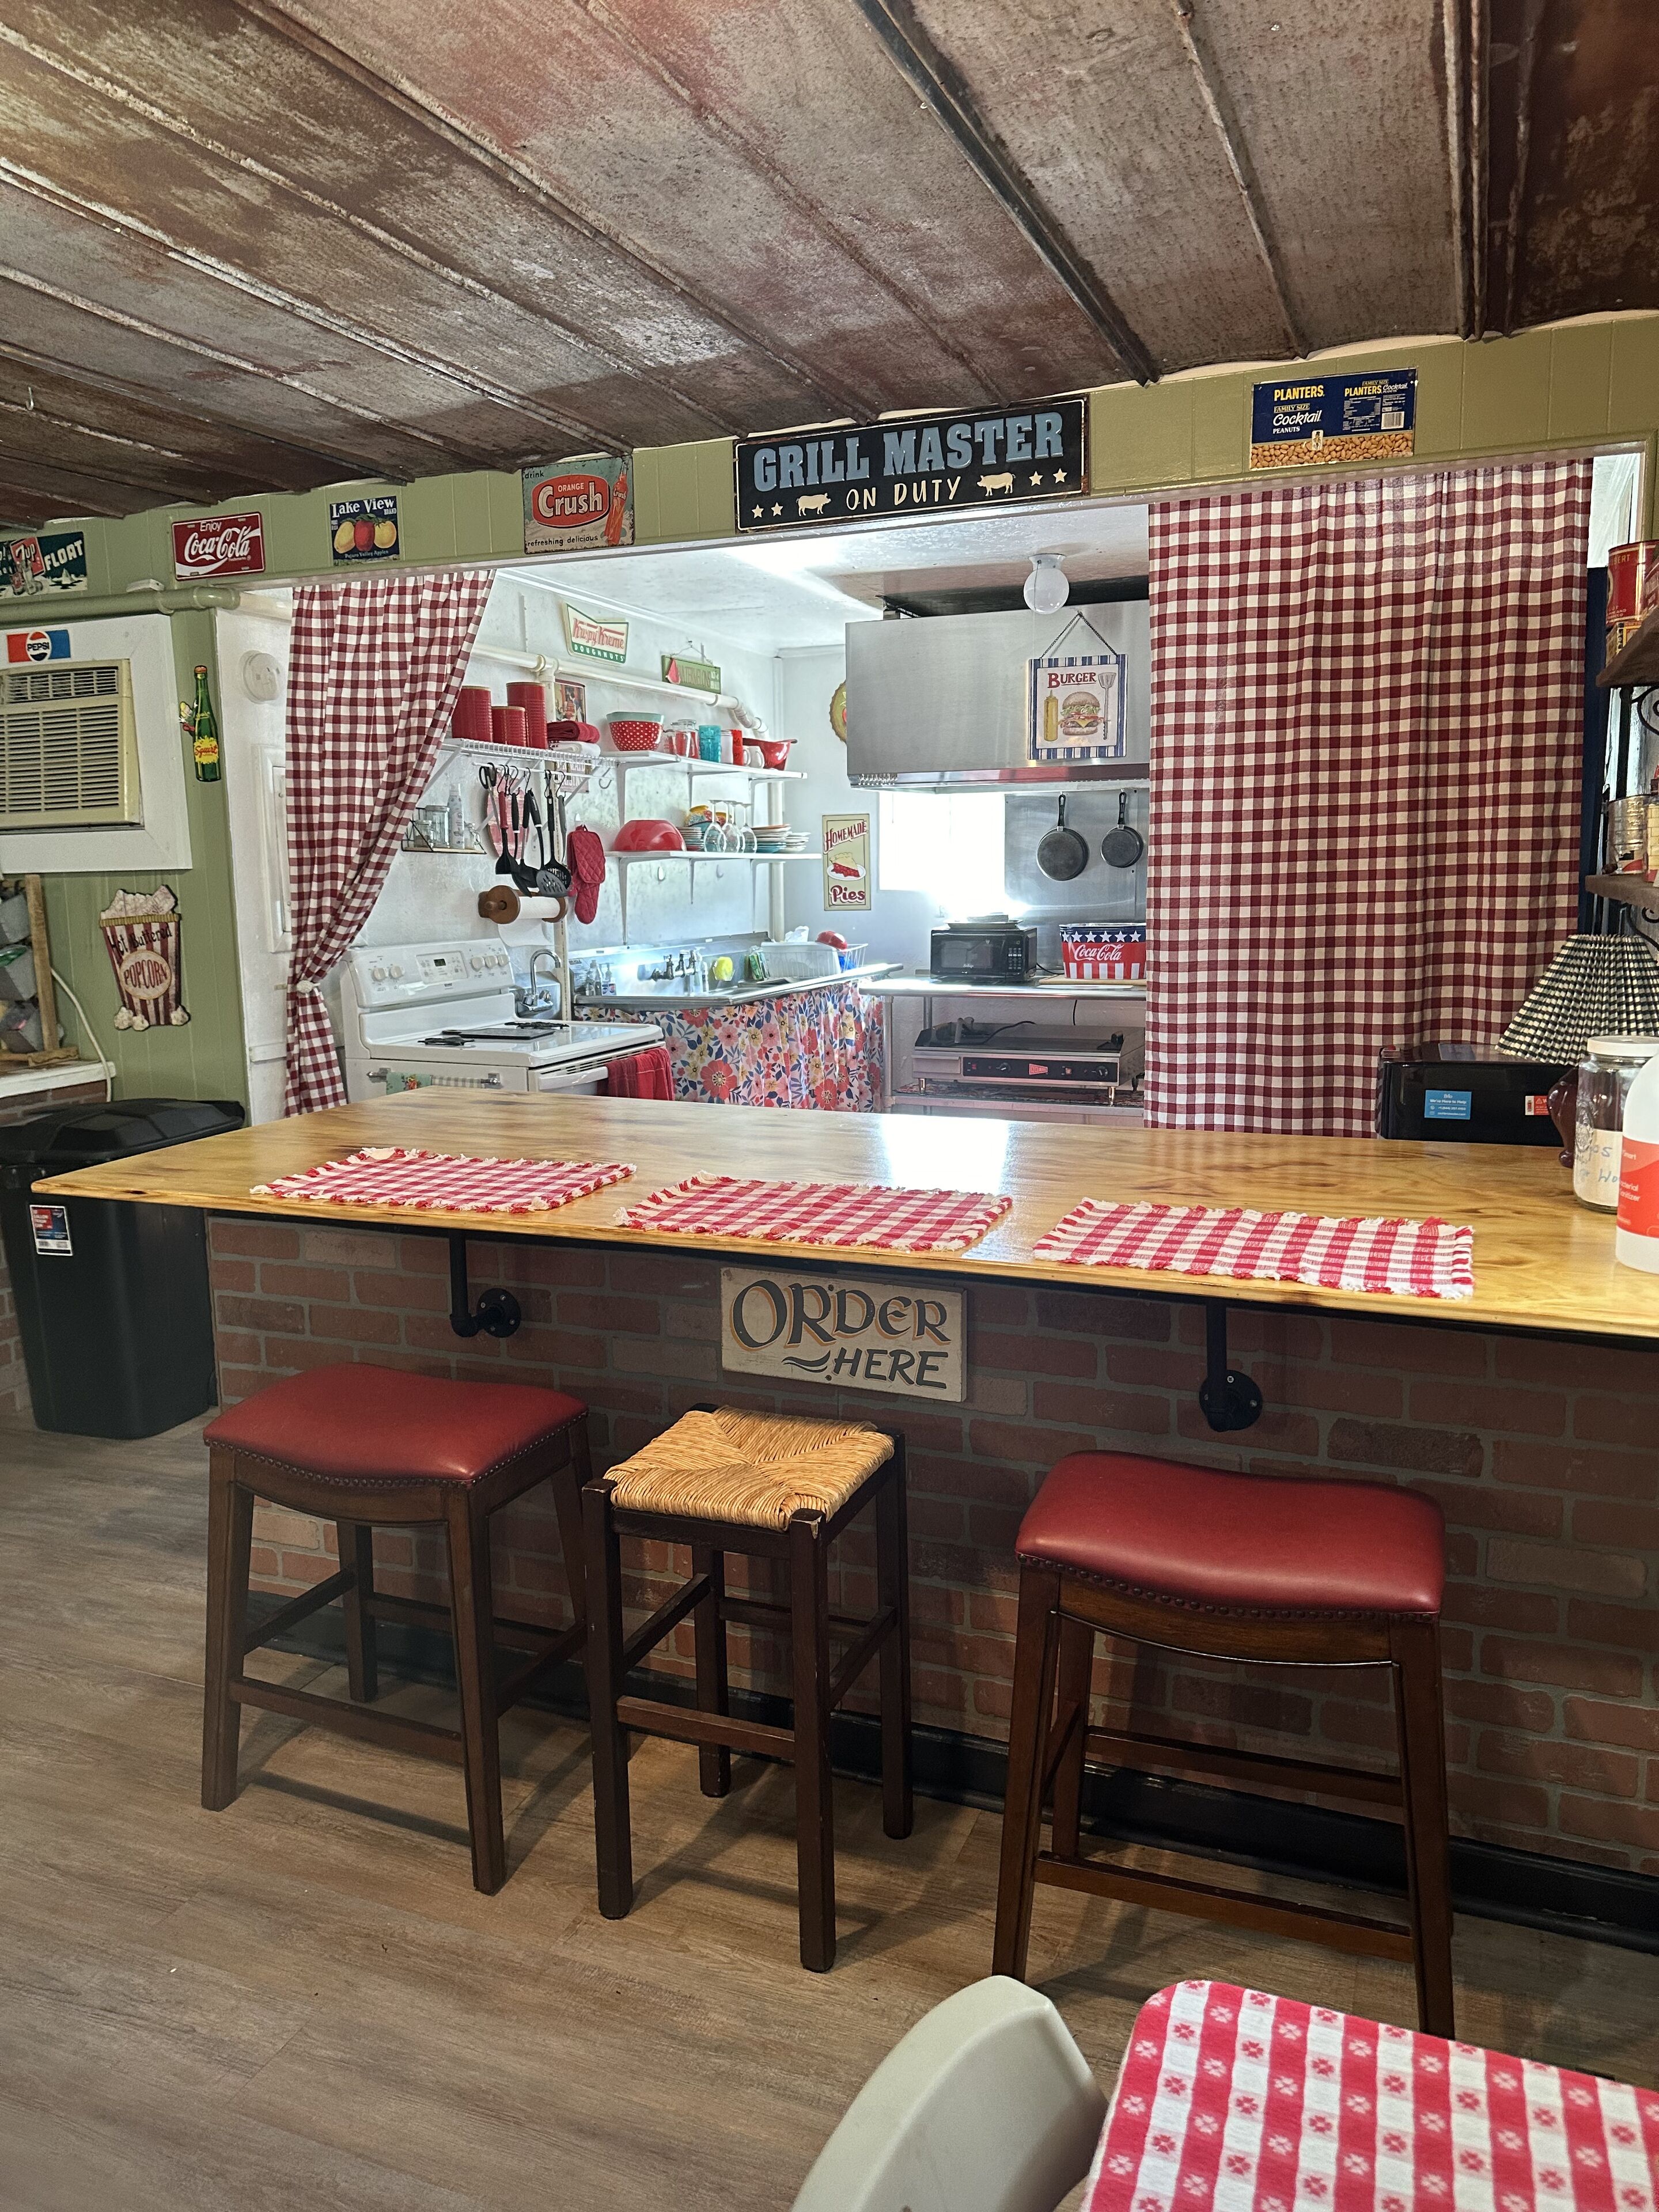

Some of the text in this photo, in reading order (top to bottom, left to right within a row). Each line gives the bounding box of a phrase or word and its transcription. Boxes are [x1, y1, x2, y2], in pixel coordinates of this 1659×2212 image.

[1274, 385, 1324, 401] PLANTERS
[1344, 385, 1382, 397] PLANTERS
[1273, 410, 1322, 426] Cocktail
[1272, 426, 1300, 434] PEANUTS
[753, 411, 1064, 492] GRILL MASTER
[525, 470, 544, 479] drink
[558, 482, 585, 493] ORANGE
[613, 488, 627, 500] Crush
[846, 476, 961, 510] ON DUTY
[332, 498, 394, 518] Lake View
[538, 481, 603, 518] Crush
[200, 521, 222, 532] Enjoy
[184, 526, 251, 563] Coca-Cola
[528, 535, 599, 547] refreshing delicious
[44, 540, 84, 571] FLOAT
[573, 618, 624, 650] Krispy Kreme
[27, 642, 50, 652] PEPSI
[574, 644, 624, 662] DOUGHNUTS
[1047, 672, 1097, 688] BURGER
[824, 820, 867, 853] HOMEMADE
[830, 885, 866, 903] Pies
[108, 922, 173, 956] Hot Buttered
[1074, 943, 1124, 961] Coca-Cola
[123, 959, 168, 989] POPCORN
[730, 1279, 951, 1351] ORDER
[834, 1347, 949, 1389] HERE
